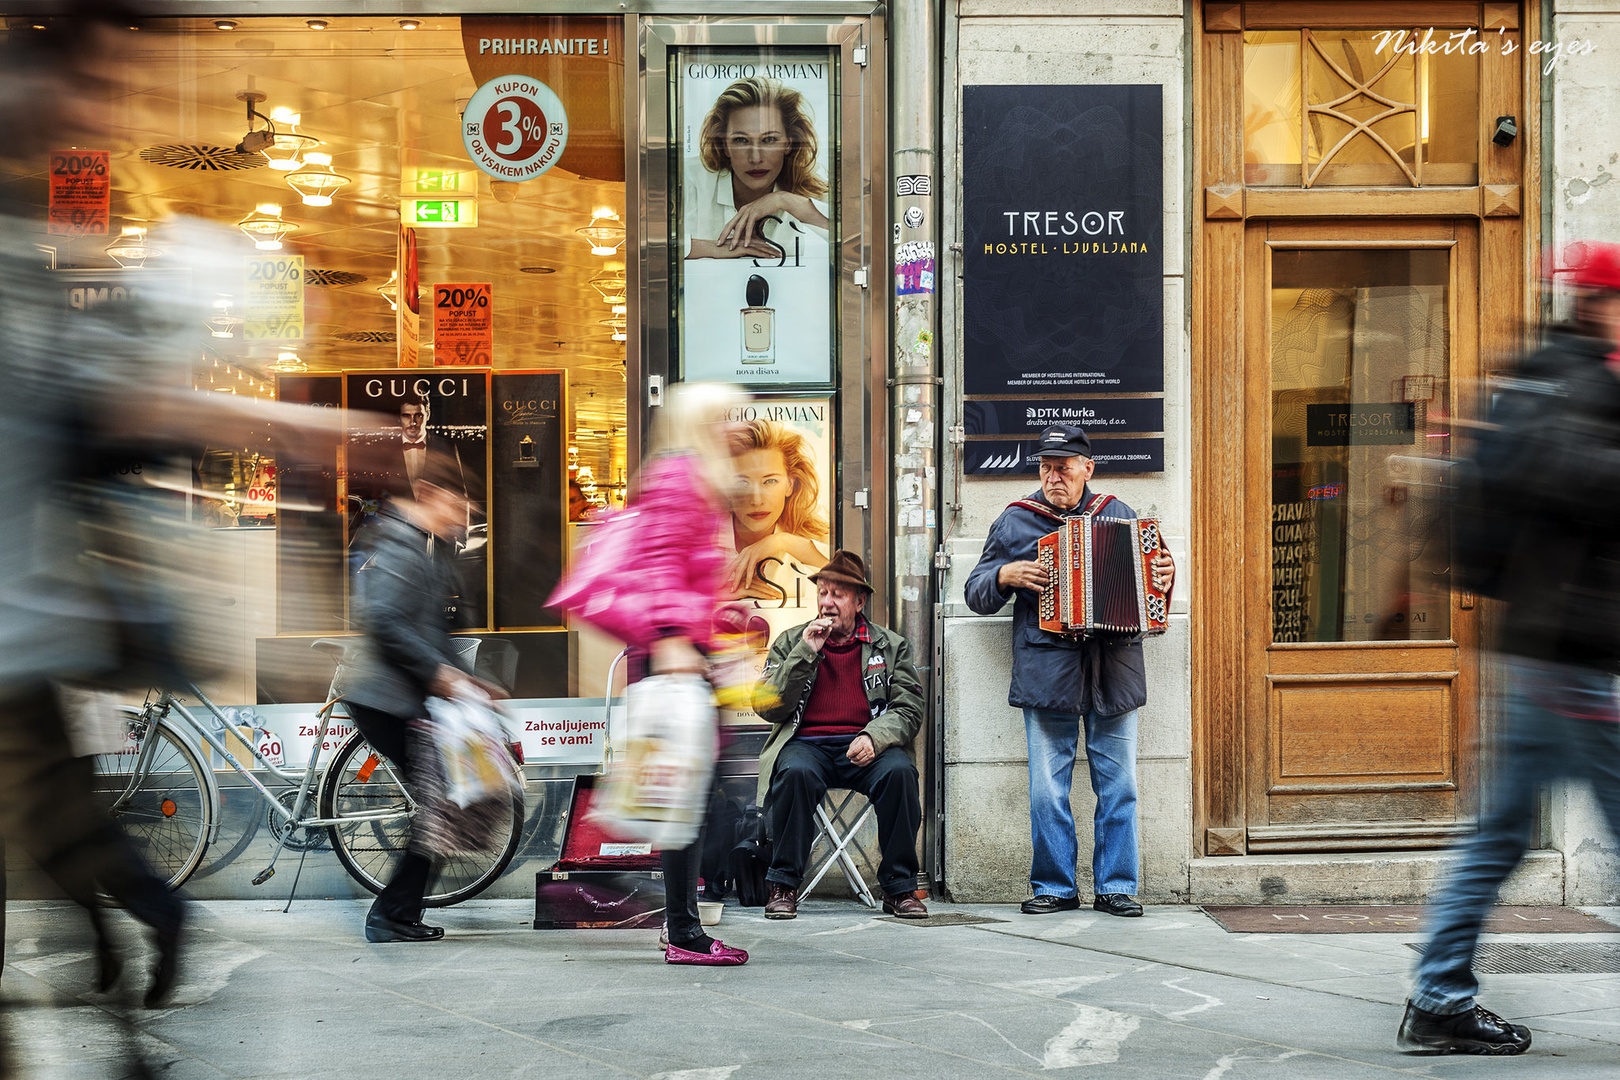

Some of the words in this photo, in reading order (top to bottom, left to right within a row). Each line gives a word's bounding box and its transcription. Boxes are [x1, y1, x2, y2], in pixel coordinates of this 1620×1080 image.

[479, 38, 599, 55] PRIHRANITE
[688, 63, 756, 79] GIORGIO
[763, 63, 824, 79] ARMANI
[494, 82, 539, 97] KUPON
[496, 100, 542, 155] 3%
[472, 139, 484, 156] OB
[481, 153, 524, 177] VSAKEM
[525, 138, 561, 175] NAKUPU
[54, 156, 106, 176] 20%
[1003, 211, 1125, 236] TRESOR
[984, 243, 1048, 254] HOSTEL
[1063, 242, 1148, 254] LJUBLJANA
[248, 261, 300, 280] 20%
[438, 288, 488, 308] 20%
[365, 378, 468, 398] GUCCI
[503, 400, 556, 410] GUCCI
[1037, 408, 1060, 418] DTK
[1062, 407, 1095, 417] Murka
[764, 406, 824, 422] ARMANI
[1328, 413, 1392, 427] TRESOR
[1308, 488, 1338, 499] OPEN
[541, 736, 556, 745] se
[559, 733, 593, 745] vam!
[260, 742, 280, 756] 60
